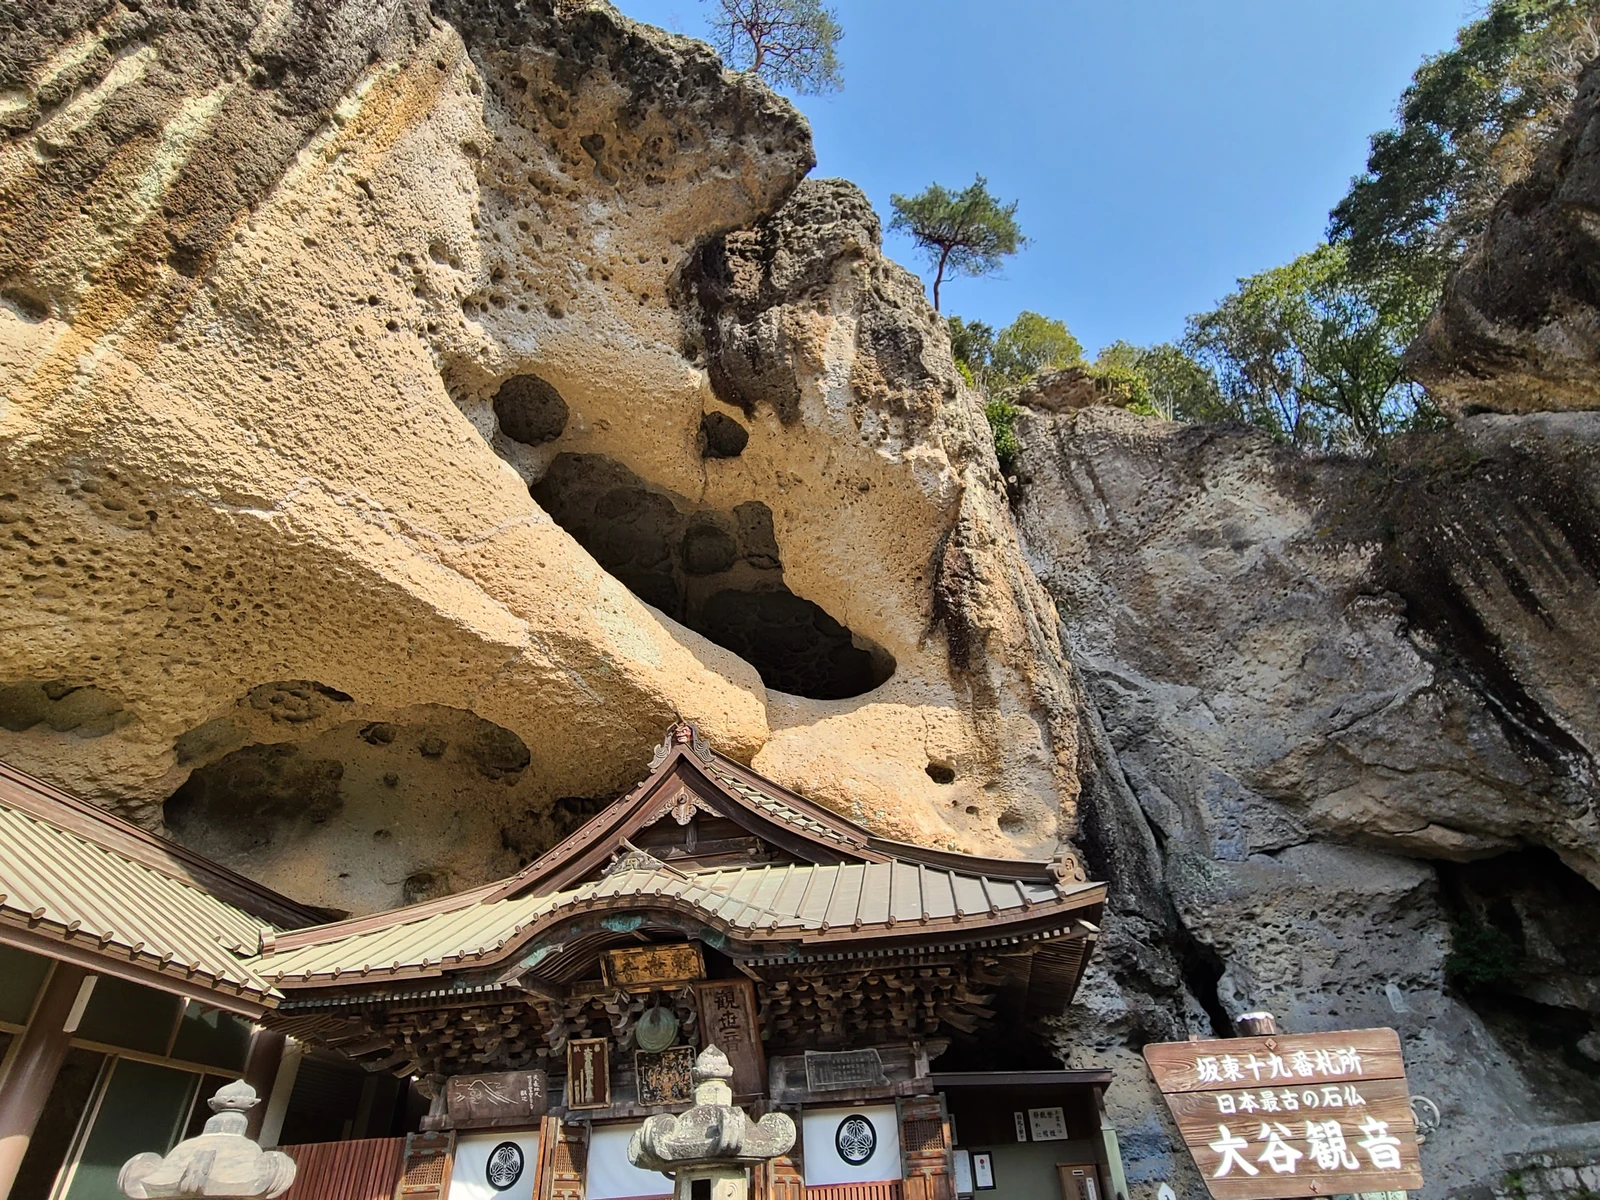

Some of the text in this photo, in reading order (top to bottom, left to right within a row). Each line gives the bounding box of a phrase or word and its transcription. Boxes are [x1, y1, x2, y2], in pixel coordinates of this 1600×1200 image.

[1196, 1047, 1363, 1083] 坂東十九番札所
[1215, 1085, 1367, 1114] 日本最古の石仏
[1209, 1115, 1402, 1178] 大谷観音
